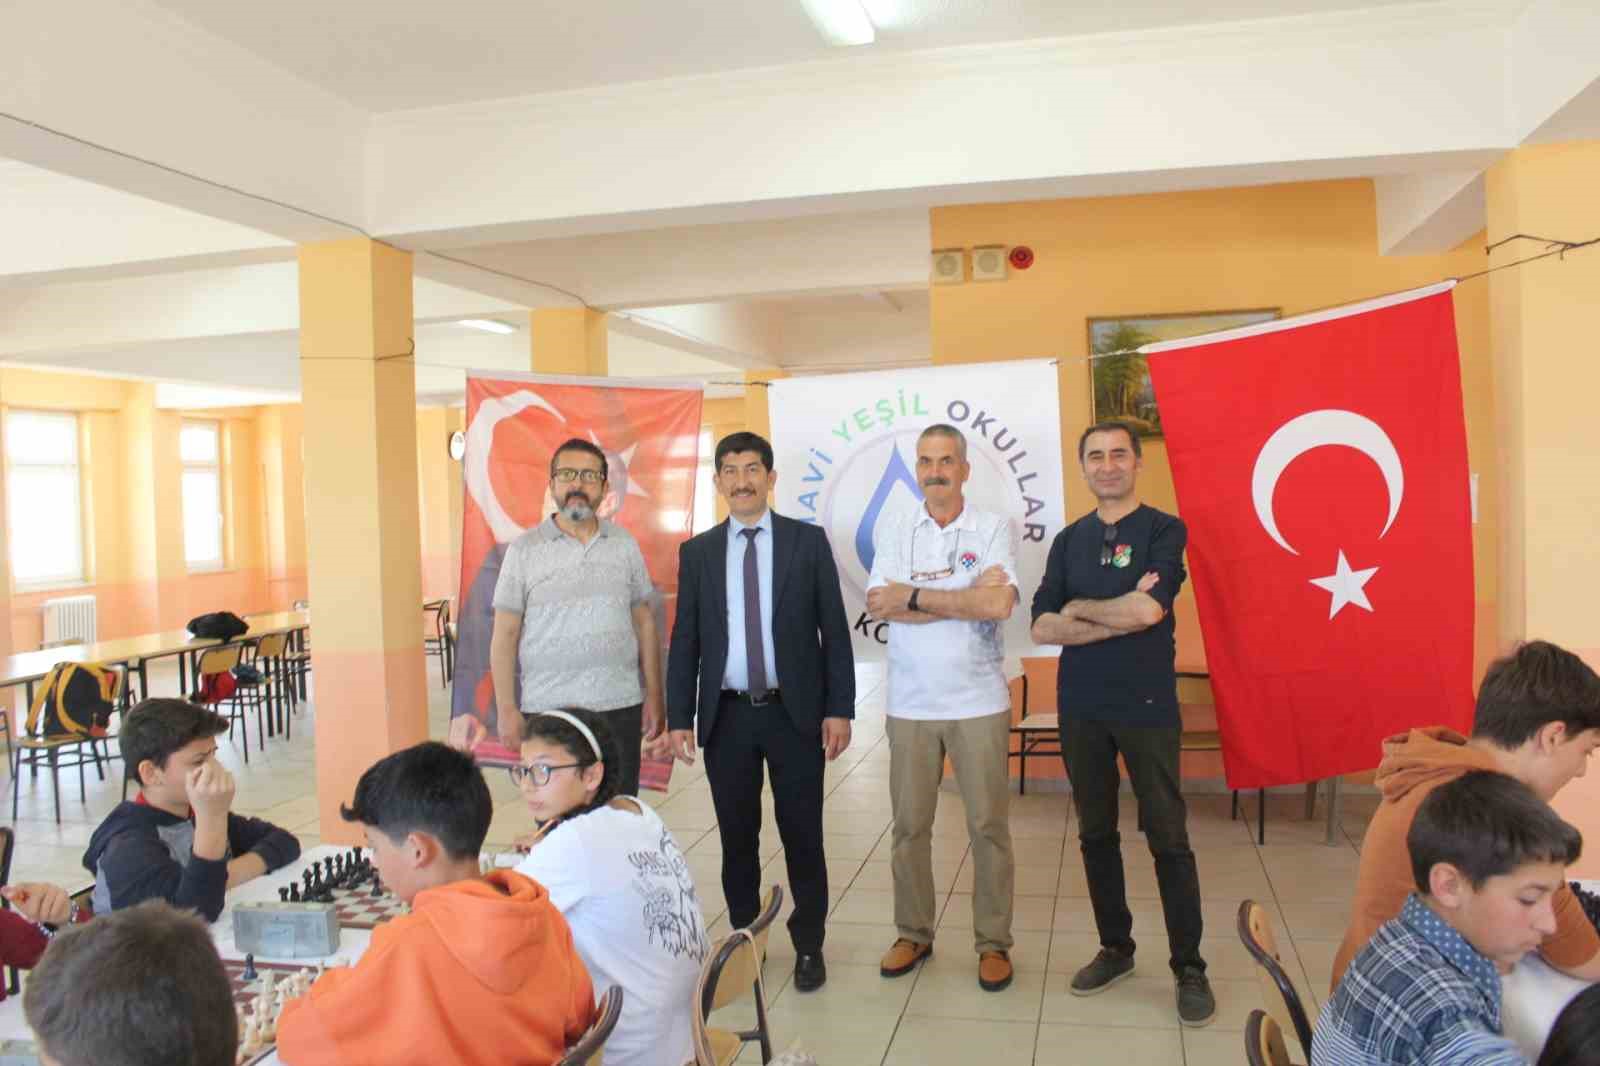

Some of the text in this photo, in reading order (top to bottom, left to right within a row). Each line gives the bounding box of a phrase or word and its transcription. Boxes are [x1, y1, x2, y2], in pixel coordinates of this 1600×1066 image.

[831, 388, 929, 441] YEŞİL
[947, 399, 1046, 543] OKULLAR
[854, 612, 889, 644] KO
